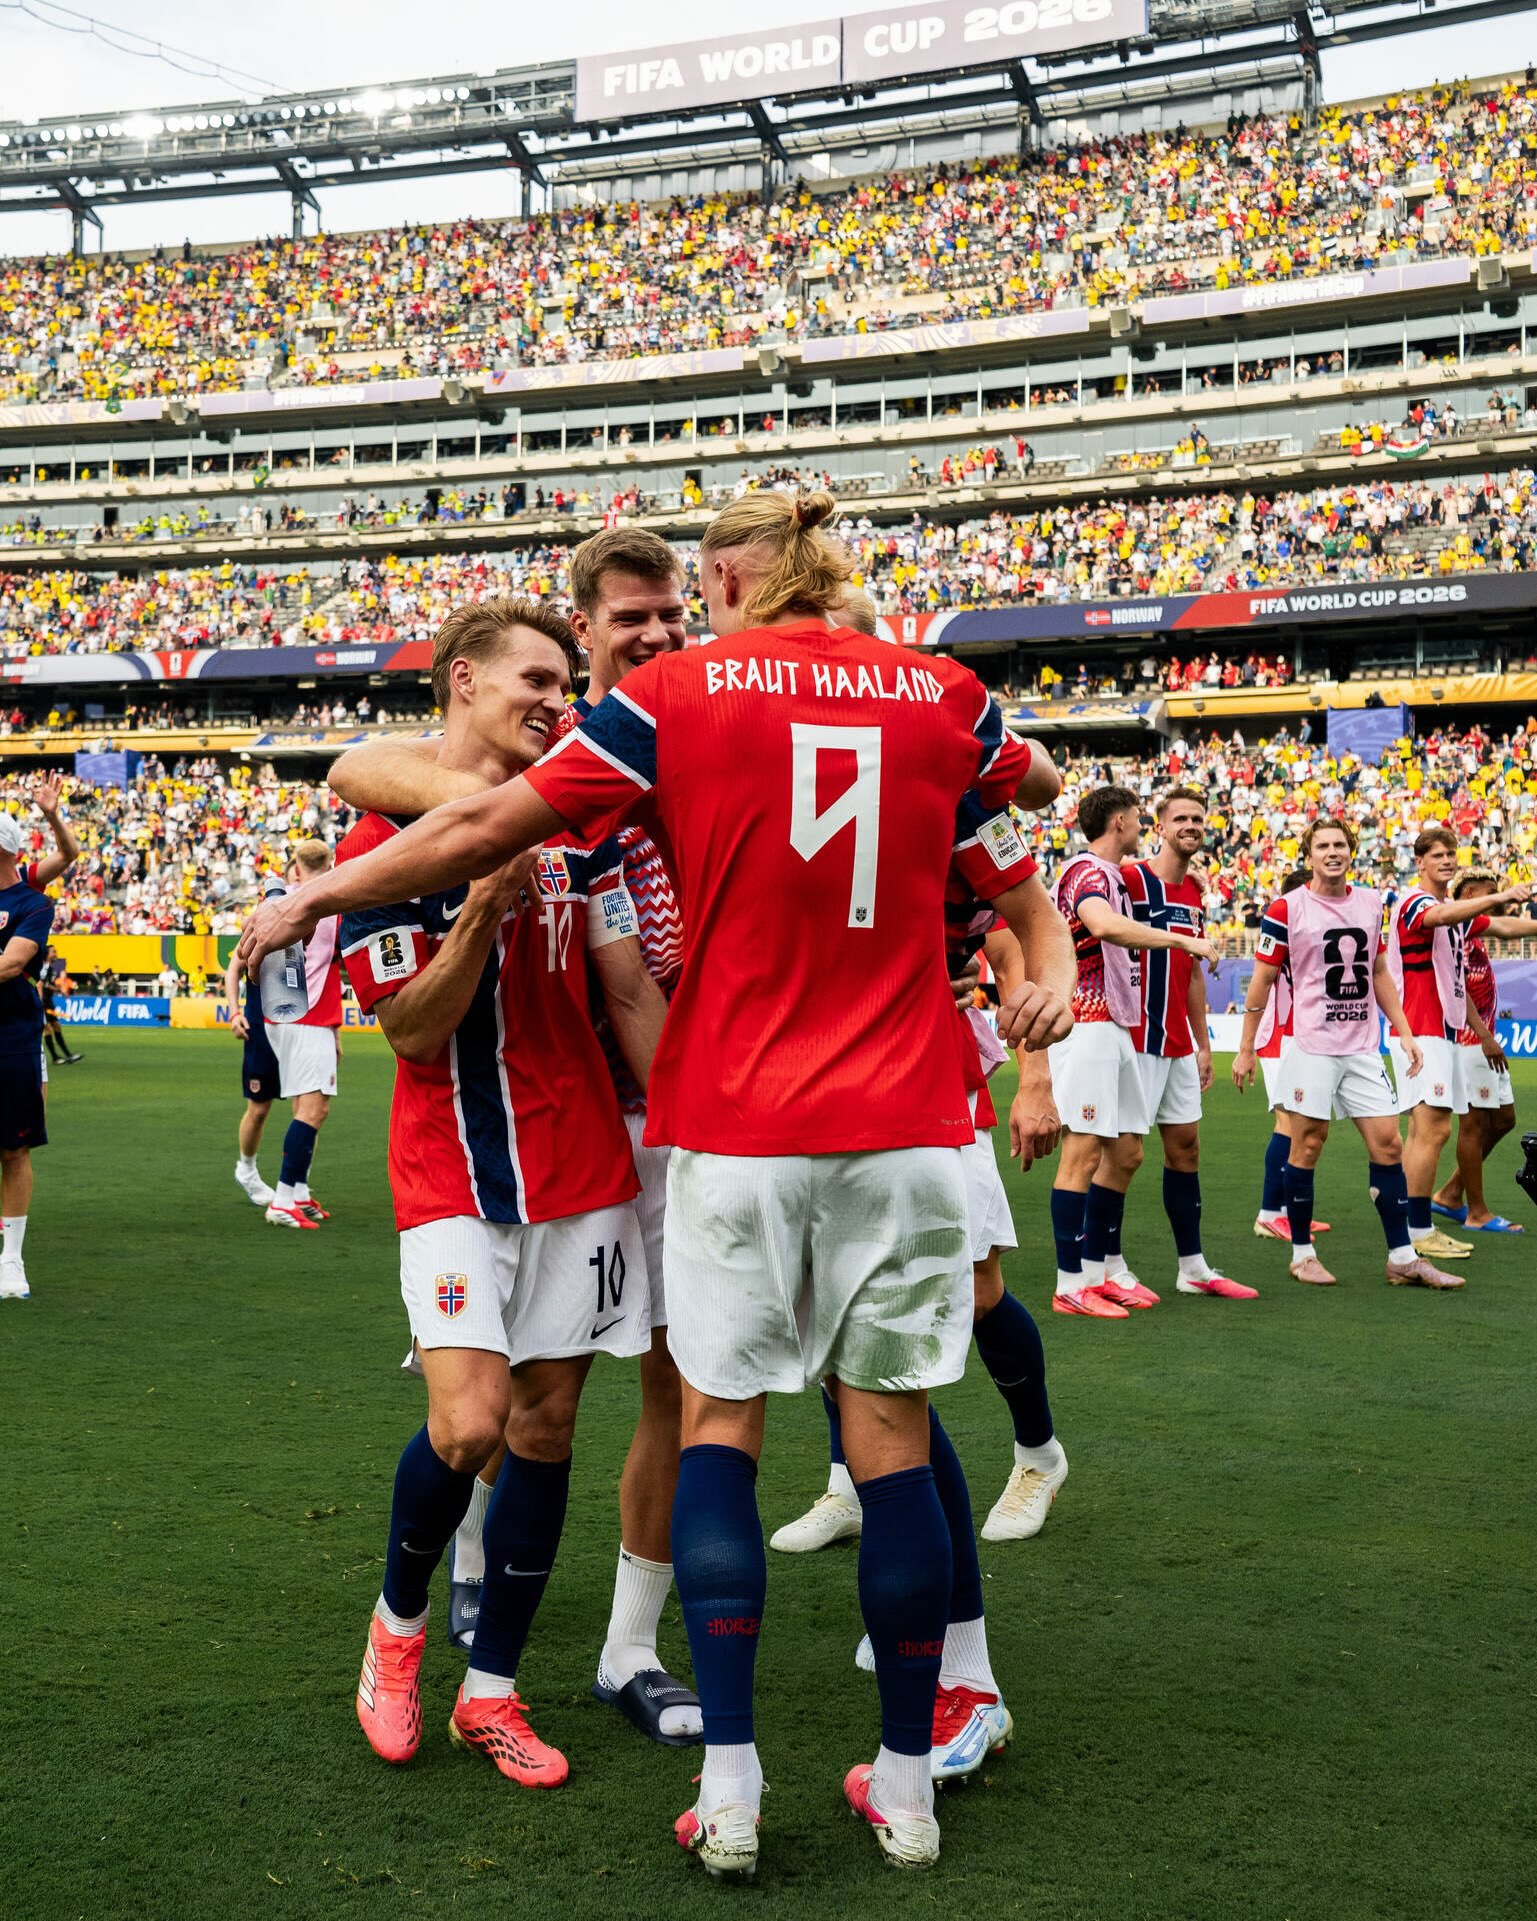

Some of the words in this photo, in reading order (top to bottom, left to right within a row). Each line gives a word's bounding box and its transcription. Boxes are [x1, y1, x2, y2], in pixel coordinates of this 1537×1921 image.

[604, 58, 685, 97] FIFA
[699, 34, 840, 84] WORLD
[863, 16, 946, 57] CUP
[963, 0, 1112, 42] 2026
[1249, 598, 1289, 615] FIFA
[1290, 592, 1357, 612] WORLD
[1358, 589, 1397, 607] CUP
[1399, 584, 1467, 605] 2026
[1111, 605, 1163, 624] NORWAY
[705, 657, 800, 695] BRAUT
[811, 663, 944, 704] HAALAND
[790, 722, 882, 929] 9
[604, 900, 630, 917] UNITES
[605, 917, 619, 929] the
[539, 903, 573, 973] 10
[1340, 985, 1358, 995] FIFA
[65, 998, 112, 1025] World
[117, 1003, 150, 1019] FIFA
[344, 1007, 377, 1026] EW
[1325, 1011, 1368, 1022] 2026
[589, 1240, 626, 1313] 10
